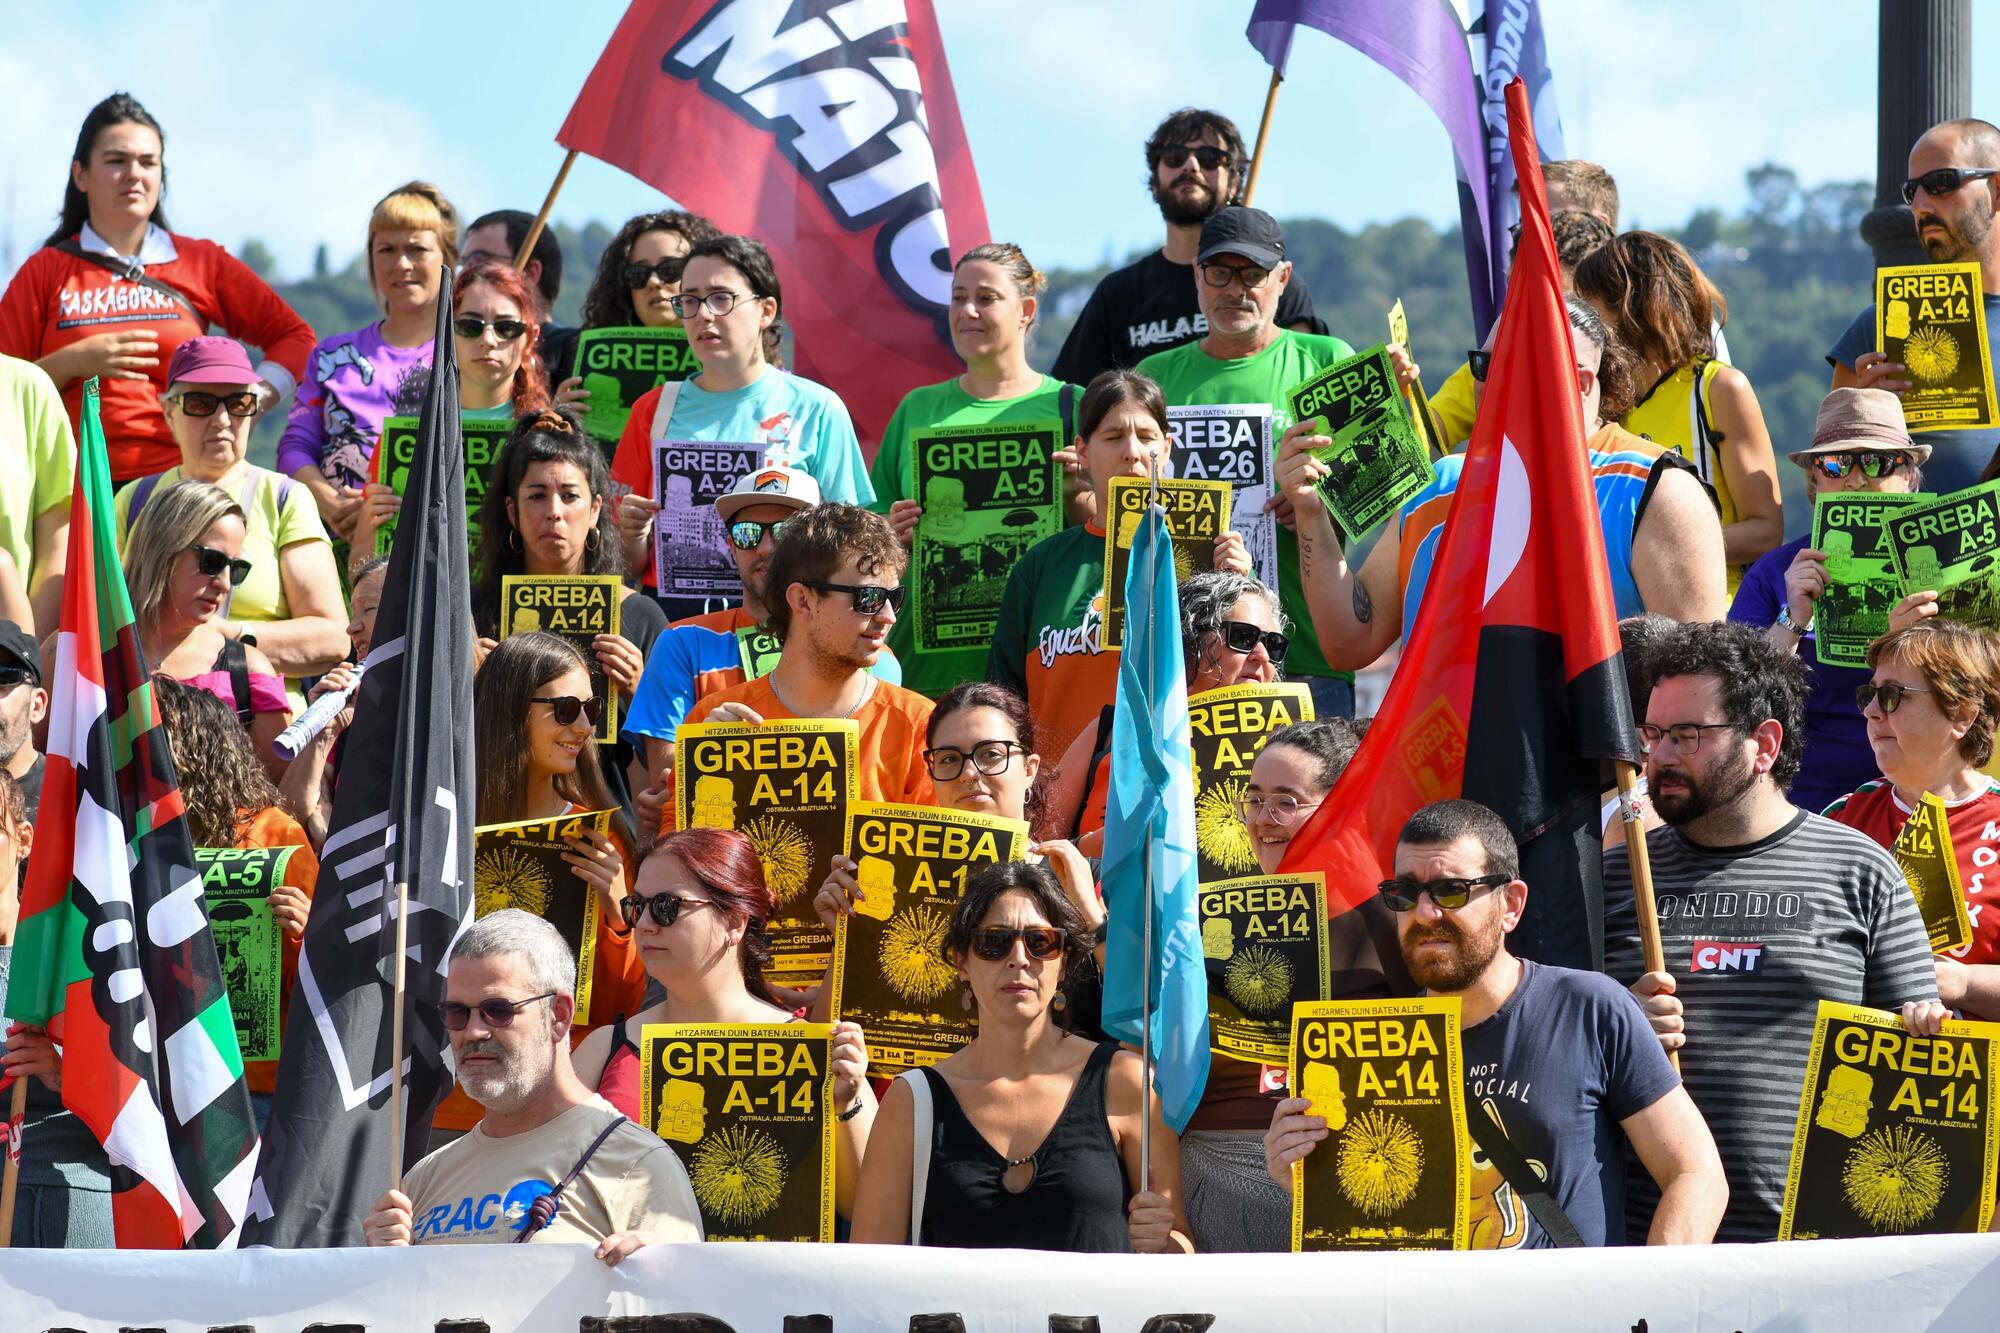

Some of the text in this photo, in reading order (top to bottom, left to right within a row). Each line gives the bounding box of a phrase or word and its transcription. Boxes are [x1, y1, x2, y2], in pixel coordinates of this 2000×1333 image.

[1887, 275, 1969, 299] GREBA
[1918, 298, 1969, 320] A-14
[587, 343, 703, 372] GREBA
[1299, 363, 1380, 417] GREBA
[1349, 379, 1384, 415] A-5
[1227, 408, 1246, 416] ALDE
[935, 428, 974, 437] HITZARMEN
[976, 427, 993, 435] DUIN
[1167, 419, 1256, 449] REBA
[665, 450, 752, 473] GREBA
[926, 439, 1047, 472] GREBA
[1183, 450, 1256, 479] A-26
[993, 469, 1045, 499] A-5
[1901, 488, 1981, 516] HITZARMEN DUIN BATEN ALDE
[1165, 514, 1213, 536] A-14
[1898, 499, 1994, 544] GREBA
[1960, 520, 1997, 554] A-5
[515, 586, 606, 607] GREBA
[549, 608, 604, 629] A-14
[1209, 693, 1229, 702] DUIN
[1231, 690, 1257, 698] BATEN
[1258, 688, 1279, 696] ALDE
[704, 724, 825, 735] HITZARMEN DUIN BATEN ALDE
[1188, 700, 1293, 738] REBA
[693, 736, 838, 773] GREBA
[750, 771, 836, 806] A-14
[872, 808, 993, 828] HITZARMEN DUIN BATEN ALDE
[511, 839, 540, 848] OSTIRALA,
[859, 819, 1000, 863] GREBA
[203, 861, 264, 887] A-5
[909, 861, 968, 897] A-1
[1210, 881, 1244, 891] HITZARMEN
[1201, 887, 1311, 916] GREBA
[793, 934, 833, 944] GREBAN
[1244, 912, 1310, 938] A-14
[580, 914, 593, 992] DESBLOKEATZEAREN
[835, 912, 848, 1000] AURREAN SEKTOREAREN
[1697, 947, 1761, 971] CNT
[269, 950, 277, 1028] DESBLOKEATZEAREN
[232, 1011, 249, 1020] BAN
[1312, 1005, 1424, 1016] HITZARMEN DUIN BATEN ALDE
[1853, 1013, 1905, 1029] HITZARMEN
[1951, 1028, 1971, 1036] ALDE
[675, 1029, 806, 1038] HITZARMEN DUIN BATEN ALDE
[934, 1032, 972, 1044] GREBAN
[1303, 1019, 1439, 1059] GREBA
[662, 1041, 818, 1077] GREBA
[887, 1051, 901, 1059] ELA
[1834, 1026, 1981, 1079] GREBA
[1357, 1060, 1439, 1098] A-14
[1449, 1035, 1460, 1111] PATRONALAREKIN
[1470, 1063, 1498, 1077] NOT
[721, 1080, 815, 1114] A-14
[1467, 1078, 1530, 1103] OCIAL
[1888, 1077, 1979, 1120] A-14
[1987, 1061, 1997, 1137] PATRONALAREKIN
[1786, 1018, 1827, 1218] AURREAN SEKTOREAREN HIRUGARREN GREBA EGUNA
[1905, 1116, 1939, 1127] OSTIRALA,
[1939, 1120, 1972, 1129] ABUZTUAK
[823, 1129, 831, 1188] NEGOZIAZIOAK
[1455, 1112, 1465, 1178] NEGOZIAZIOAK
[1984, 1138, 1994, 1206] NEGOZIAZIOAK
[1455, 1180, 1465, 1250] DESBLOKEATZEA
